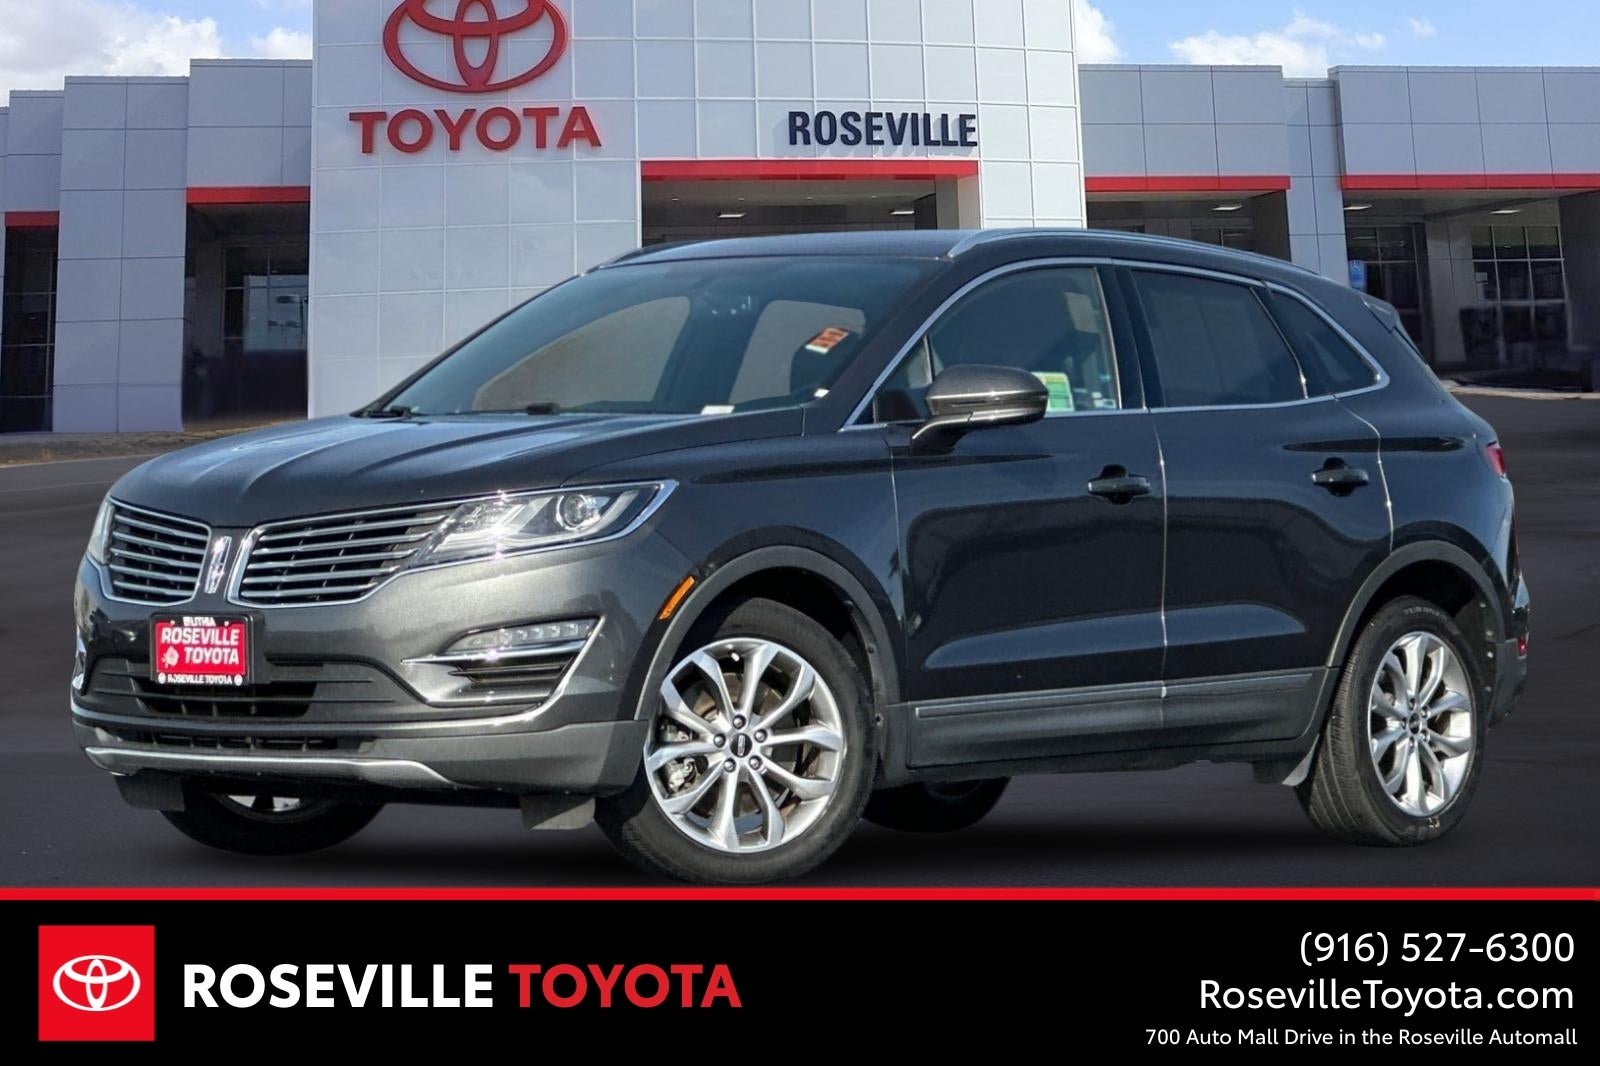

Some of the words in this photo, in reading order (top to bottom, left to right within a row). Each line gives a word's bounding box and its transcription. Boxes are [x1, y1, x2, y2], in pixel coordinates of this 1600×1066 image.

[349, 106, 602, 153] TOYOTA
[788, 110, 978, 147] ROSEVILLE
[161, 628, 240, 645] ROSEVILLE
[184, 647, 239, 665] TOYOTA
[167, 674, 205, 684] ROSEVILLE
[205, 675, 233, 684] TOYOTA
